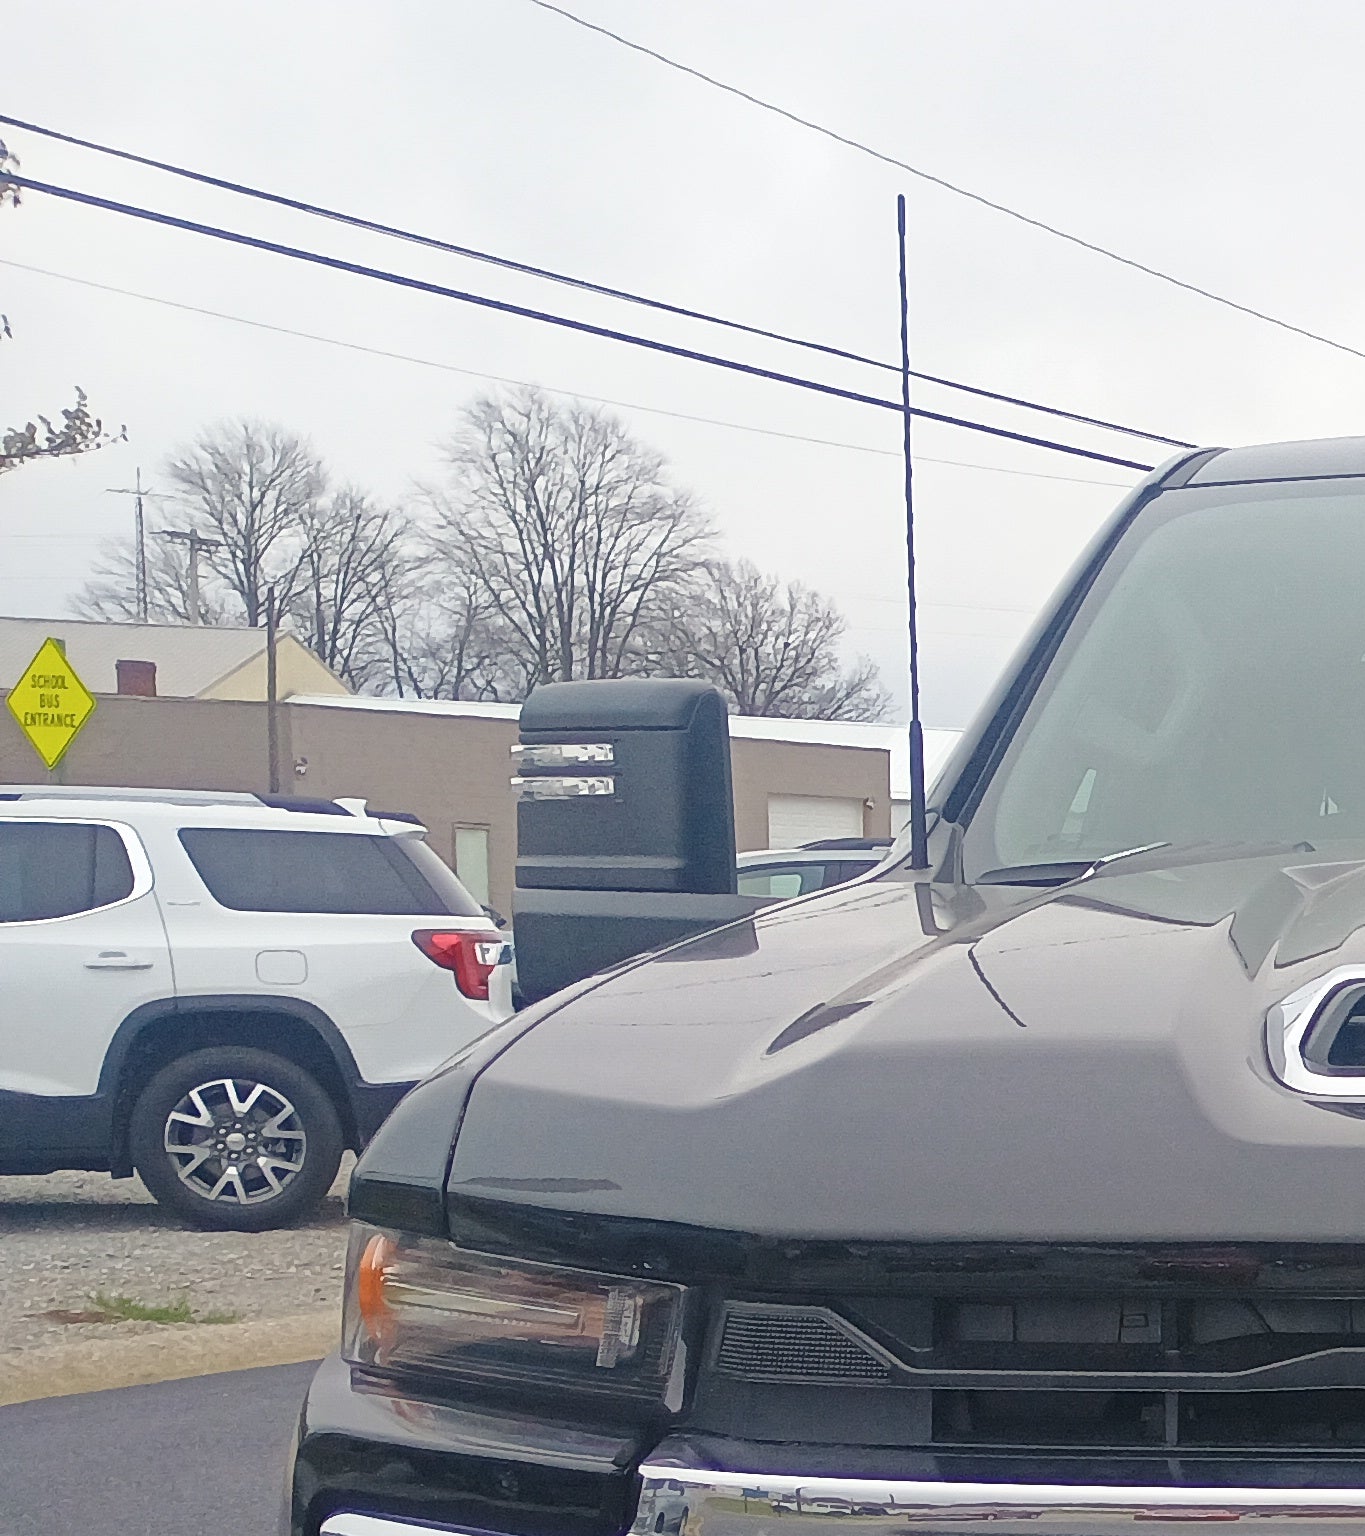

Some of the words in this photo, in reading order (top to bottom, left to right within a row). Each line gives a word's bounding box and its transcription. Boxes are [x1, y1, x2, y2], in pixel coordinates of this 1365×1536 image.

[31, 674, 68, 689] SCHOOL
[39, 693, 60, 708] BUS
[24, 712, 76, 728] ENTRANCE
